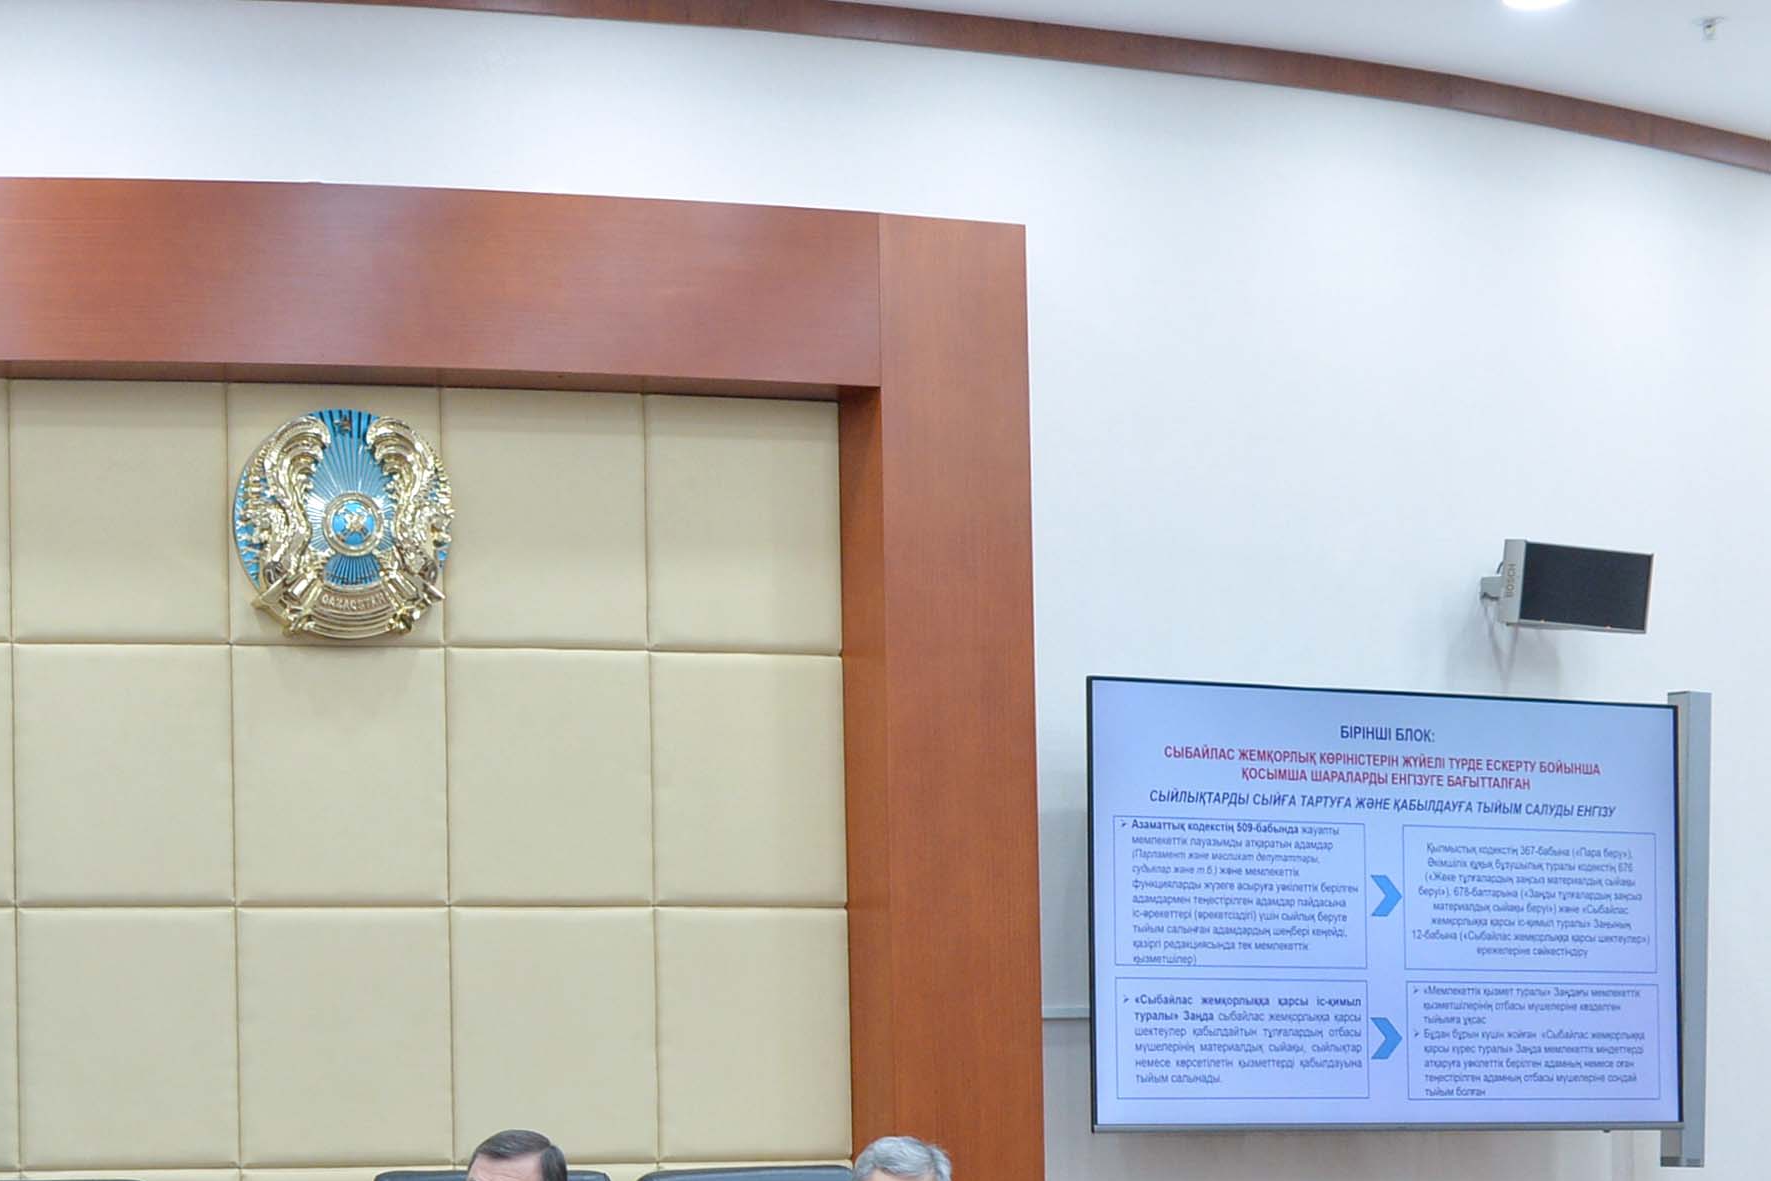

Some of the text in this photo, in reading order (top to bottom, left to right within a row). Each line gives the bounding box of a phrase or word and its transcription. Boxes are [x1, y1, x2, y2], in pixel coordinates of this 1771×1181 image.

[1507, 563, 1516, 598] BOSCH
[1340, 725, 1434, 742] БІРІНШІ БЛОК:
[1163, 742, 1600, 775] СЫБАЙЛАС ЖЕМҚОРЛЫҚ КӨРІНІСТЕРІН ЖҮЙЕЛІ ТҮРДЕ ЕСКЕРТУ БОЙЫНША
[1241, 765, 1530, 790] ҚОСЫМША ШАРАЛАРДЫ ЕНГІЗУГЕ БАҒЫТТАЛҒАН
[1149, 789, 1616, 818] СЫЙЛЫҚТАРДЫ СЫЙҒА ТАРТУҒА ЖӘНЕ ҚАБЫЛДАУҒА ТЫЙЫМ САЛУДЫ ЕНГІЗУ
